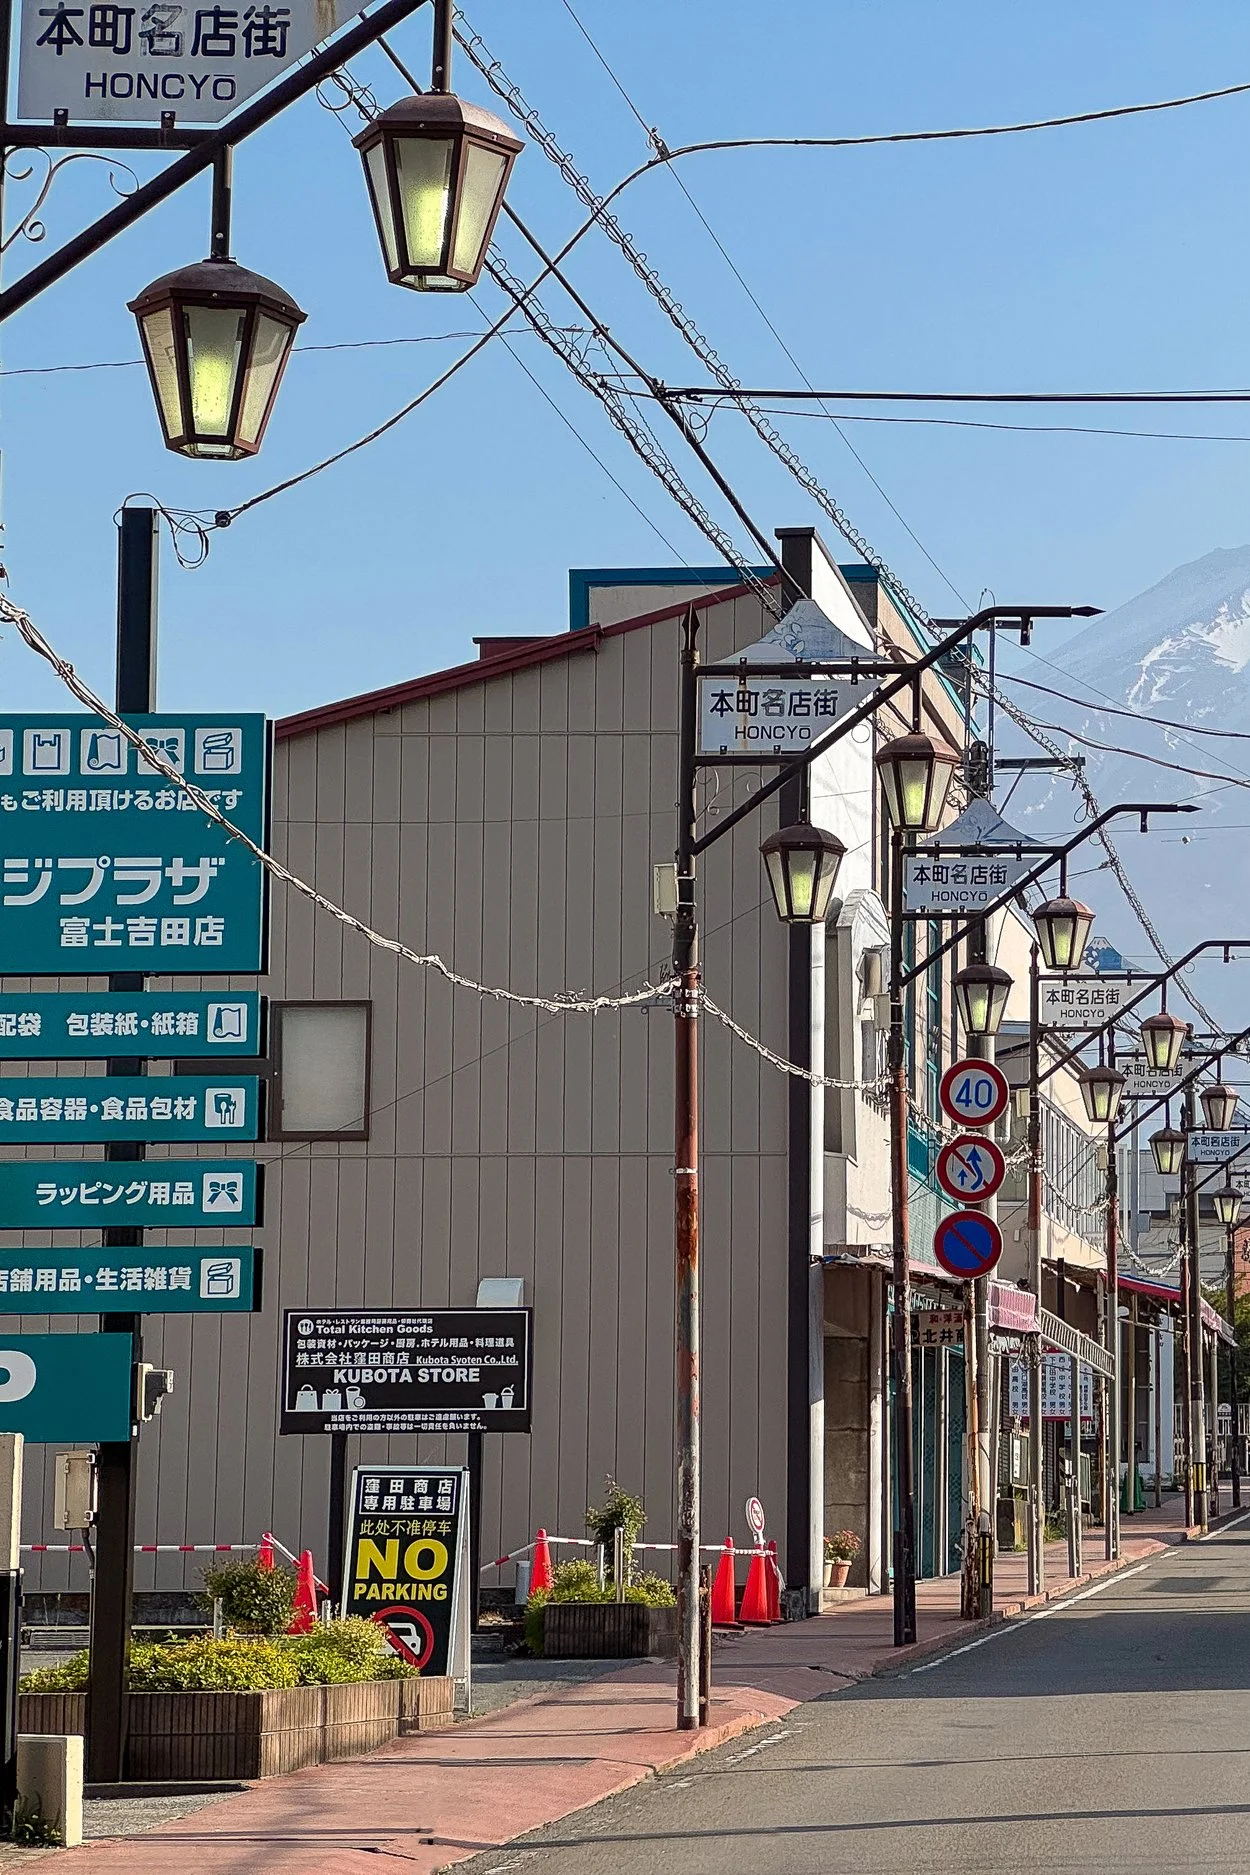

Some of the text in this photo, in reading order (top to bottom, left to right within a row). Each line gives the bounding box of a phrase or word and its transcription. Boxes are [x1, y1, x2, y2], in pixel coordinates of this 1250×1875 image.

[36, 2, 291, 58] 本町名店街
[710, 688, 839, 718] 本町名店街
[1, 789, 243, 811] もご利用頂けるお店です
[3, 856, 225, 905] ジプラザ
[913, 864, 1007, 885] 本町名店街
[60, 916, 225, 947] 富士吉田店
[1046, 988, 1120, 1005] 本町名店街
[66, 1012, 199, 1037] 包装紙・紙箱
[955, 1078, 993, 1109] 40
[0, 1097, 197, 1121] 食品容器・食品包材
[36, 1181, 195, 1206] ラッピング用品
[316, 1324, 433, 1334] Total Kitchen Goods
[296, 1352, 410, 1365] 株式会社窪田商店
[416, 1355, 449, 1364] Kubota
[451, 1355, 482, 1366] Syoten
[333, 1367, 480, 1384] KUBOTA STORE
[365, 1479, 453, 1493] 窪田商店
[363, 1496, 452, 1511] 専用駐車場
[360, 1519, 451, 1537] 此处不准停车
[355, 1538, 449, 1580] NO
[354, 1583, 448, 1600] PARKING
